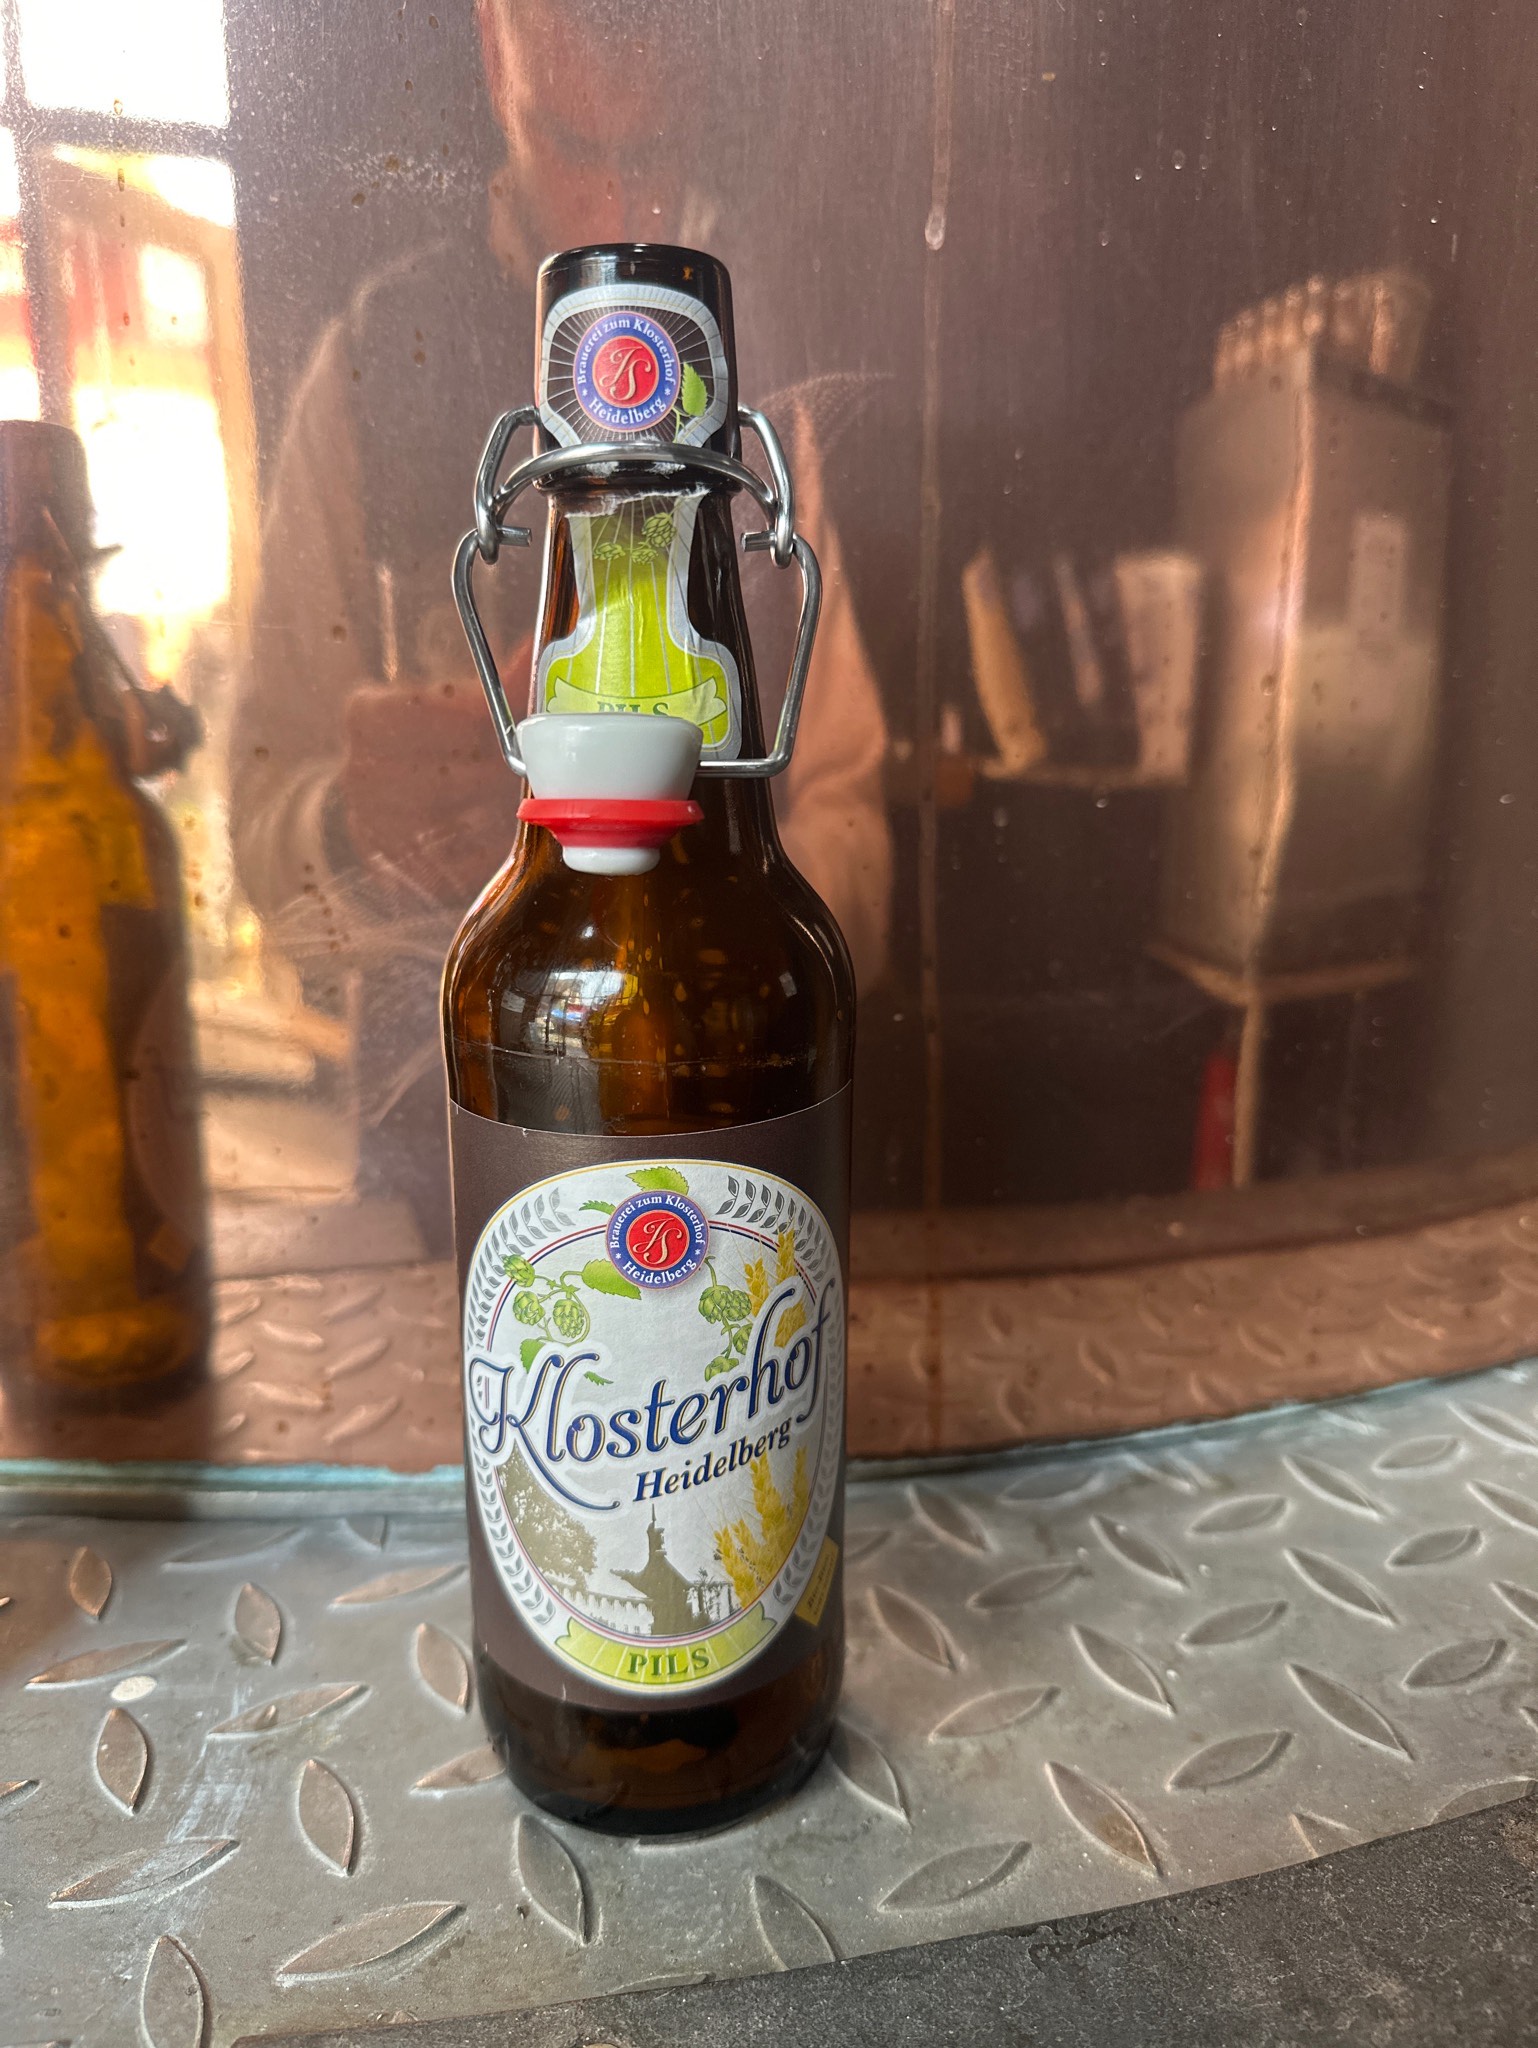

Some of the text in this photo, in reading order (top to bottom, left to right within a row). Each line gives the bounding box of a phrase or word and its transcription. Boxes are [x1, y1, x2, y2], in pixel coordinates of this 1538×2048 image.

[577, 317, 677, 386] Brauerei zum Klosterhof
[588, 397, 667, 425] Heidelberg
[609, 1194, 706, 1248] Brauerei zum Klosterhof
[622, 1259, 697, 1285] Heidelberg
[469, 1279, 836, 1511] Klosterhof
[633, 1417, 792, 1502] Heidelberg
[627, 1647, 710, 1676] PILS
